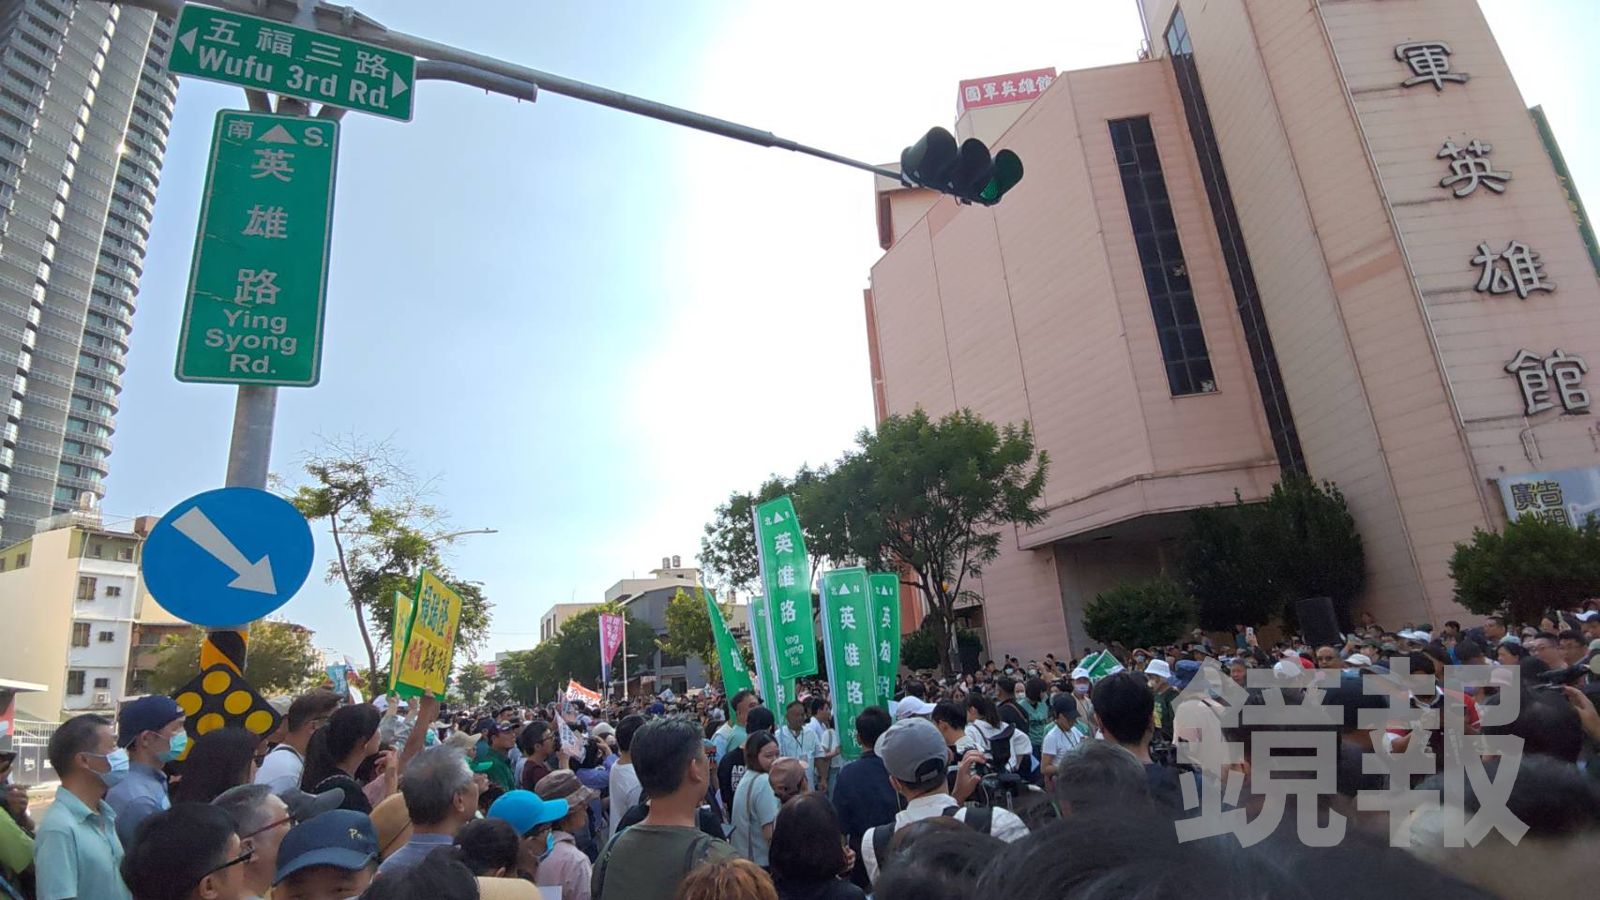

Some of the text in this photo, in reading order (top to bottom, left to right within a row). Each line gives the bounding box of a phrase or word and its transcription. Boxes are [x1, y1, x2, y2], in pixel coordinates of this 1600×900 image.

[203, 17, 389, 80] 五福三路
[199, 46, 389, 110] Wufu 3rd Rd.
[227, 119, 254, 140] 南
[303, 126, 329, 147] S.
[233, 148, 295, 305] 英雄路
[1394, 40, 1591, 417] 軍英雄館
[205, 328, 297, 355] Syong
[223, 309, 287, 333] Ying
[229, 354, 277, 374] Rd.
[1510, 480, 1563, 511] 廣告
[774, 532, 797, 624] 英雄路
[839, 606, 863, 705] 英雄路
